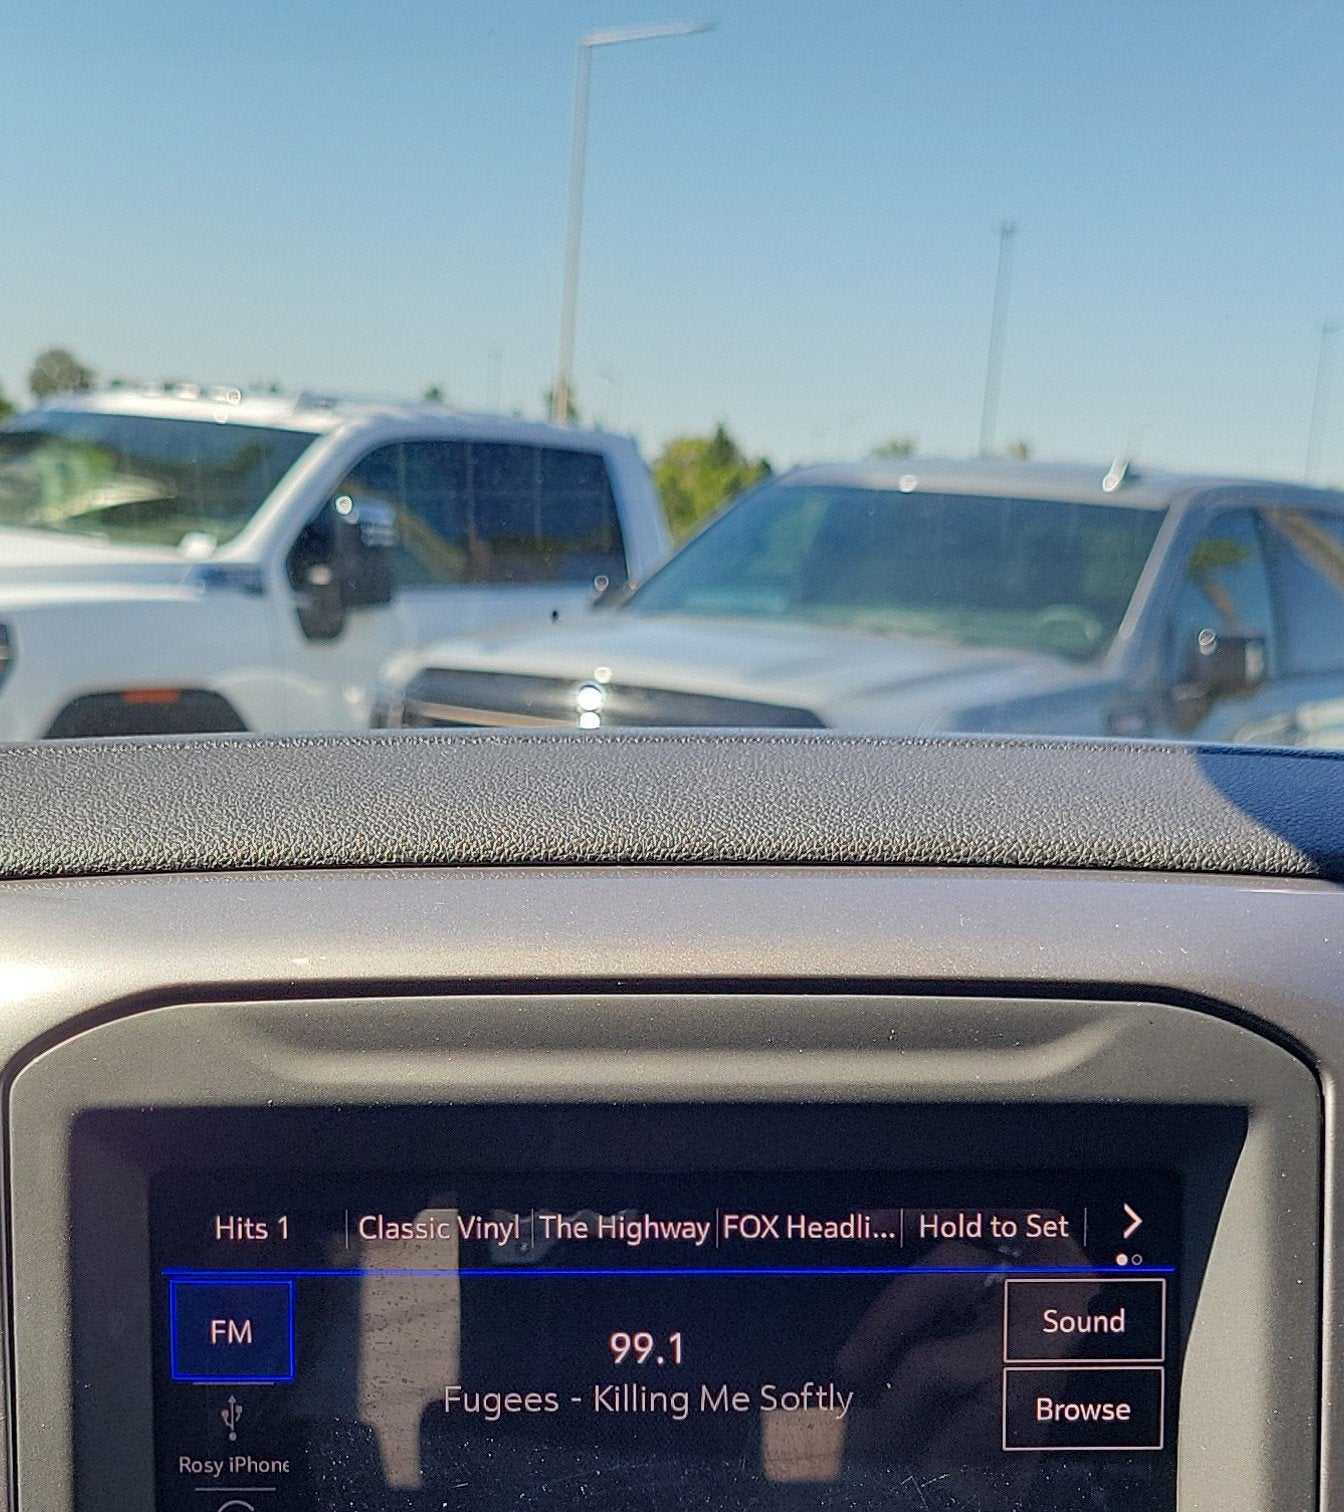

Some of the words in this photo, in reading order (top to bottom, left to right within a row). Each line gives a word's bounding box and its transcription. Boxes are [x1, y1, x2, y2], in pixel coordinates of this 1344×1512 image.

[215, 1215, 269, 1240] Hits
[278, 1215, 289, 1239] 1
[358, 1214, 451, 1240] Classic
[457, 1213, 521, 1246] Vinyl
[538, 1215, 588, 1240] The
[598, 1213, 711, 1246] Highway
[723, 1214, 778, 1239] FOX
[786, 1212, 896, 1240] Headli...
[919, 1212, 983, 1239] Hold
[990, 1215, 1017, 1239] to
[1025, 1213, 1070, 1239] Set
[210, 1319, 254, 1345] FM
[1042, 1307, 1126, 1334] Sound
[609, 1332, 684, 1365] 99.1
[444, 1385, 560, 1421] Fugees
[594, 1384, 689, 1421] Killing
[699, 1385, 751, 1412] Me
[760, 1383, 854, 1420] Softly
[1036, 1397, 1132, 1422] Browse
[178, 1456, 224, 1478] Rosy
[228, 1455, 290, 1474] iPhone
